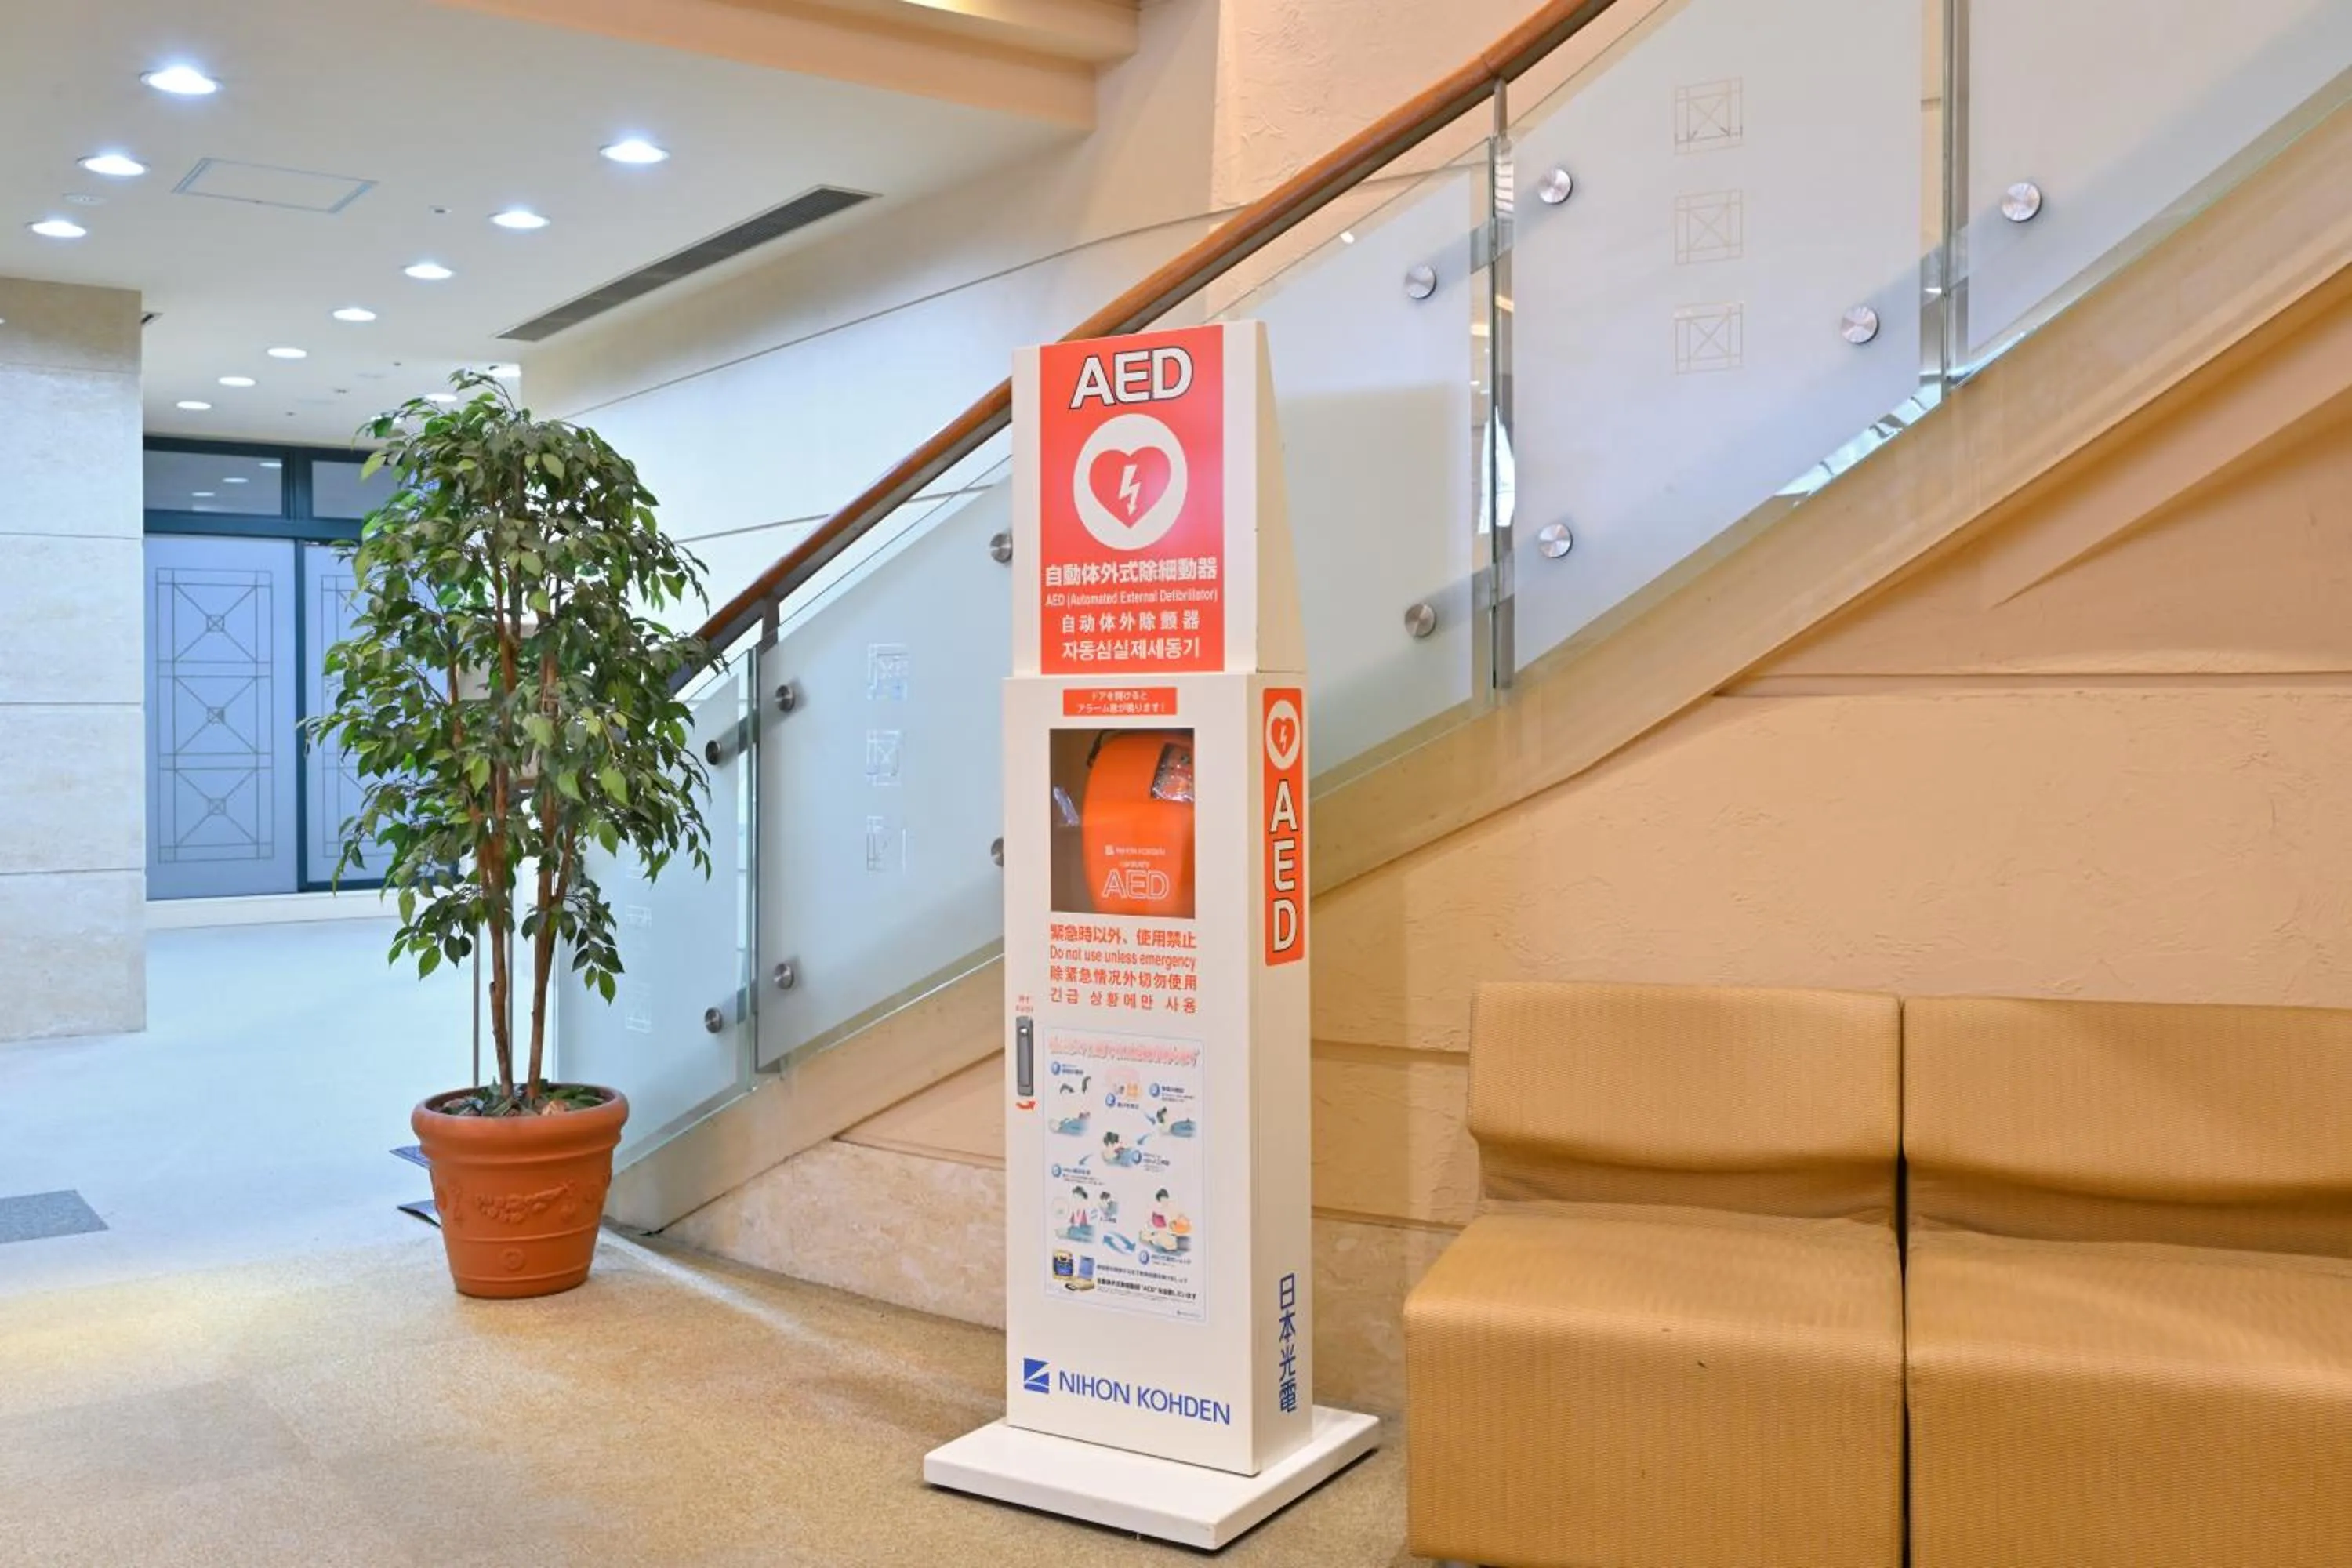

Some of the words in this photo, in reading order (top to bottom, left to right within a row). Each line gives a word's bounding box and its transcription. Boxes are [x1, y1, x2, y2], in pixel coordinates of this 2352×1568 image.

[1069, 346, 1193, 409] AED
[1045, 557, 1218, 586] 自動体外式除細動器
[1046, 593, 1065, 606] AED
[1067, 591, 1117, 608] (Automated
[1120, 590, 1157, 604] External
[1269, 779, 1298, 953] AED
[1102, 868, 1170, 900] AED
[1051, 924, 1196, 948] 緊急時以外、使用禁止
[1051, 945, 1063, 960] Do
[1065, 947, 1081, 961] not
[1084, 950, 1102, 962] use
[1105, 949, 1137, 964] unless
[1139, 953, 1197, 971] emergency
[1051, 988, 1079, 1004] 긴급
[1165, 996, 1196, 1014] 사용
[1279, 1273, 1297, 1413] 日本光電
[1059, 1370, 1131, 1404] NIHON
[1138, 1385, 1230, 1425] KOHDEN
